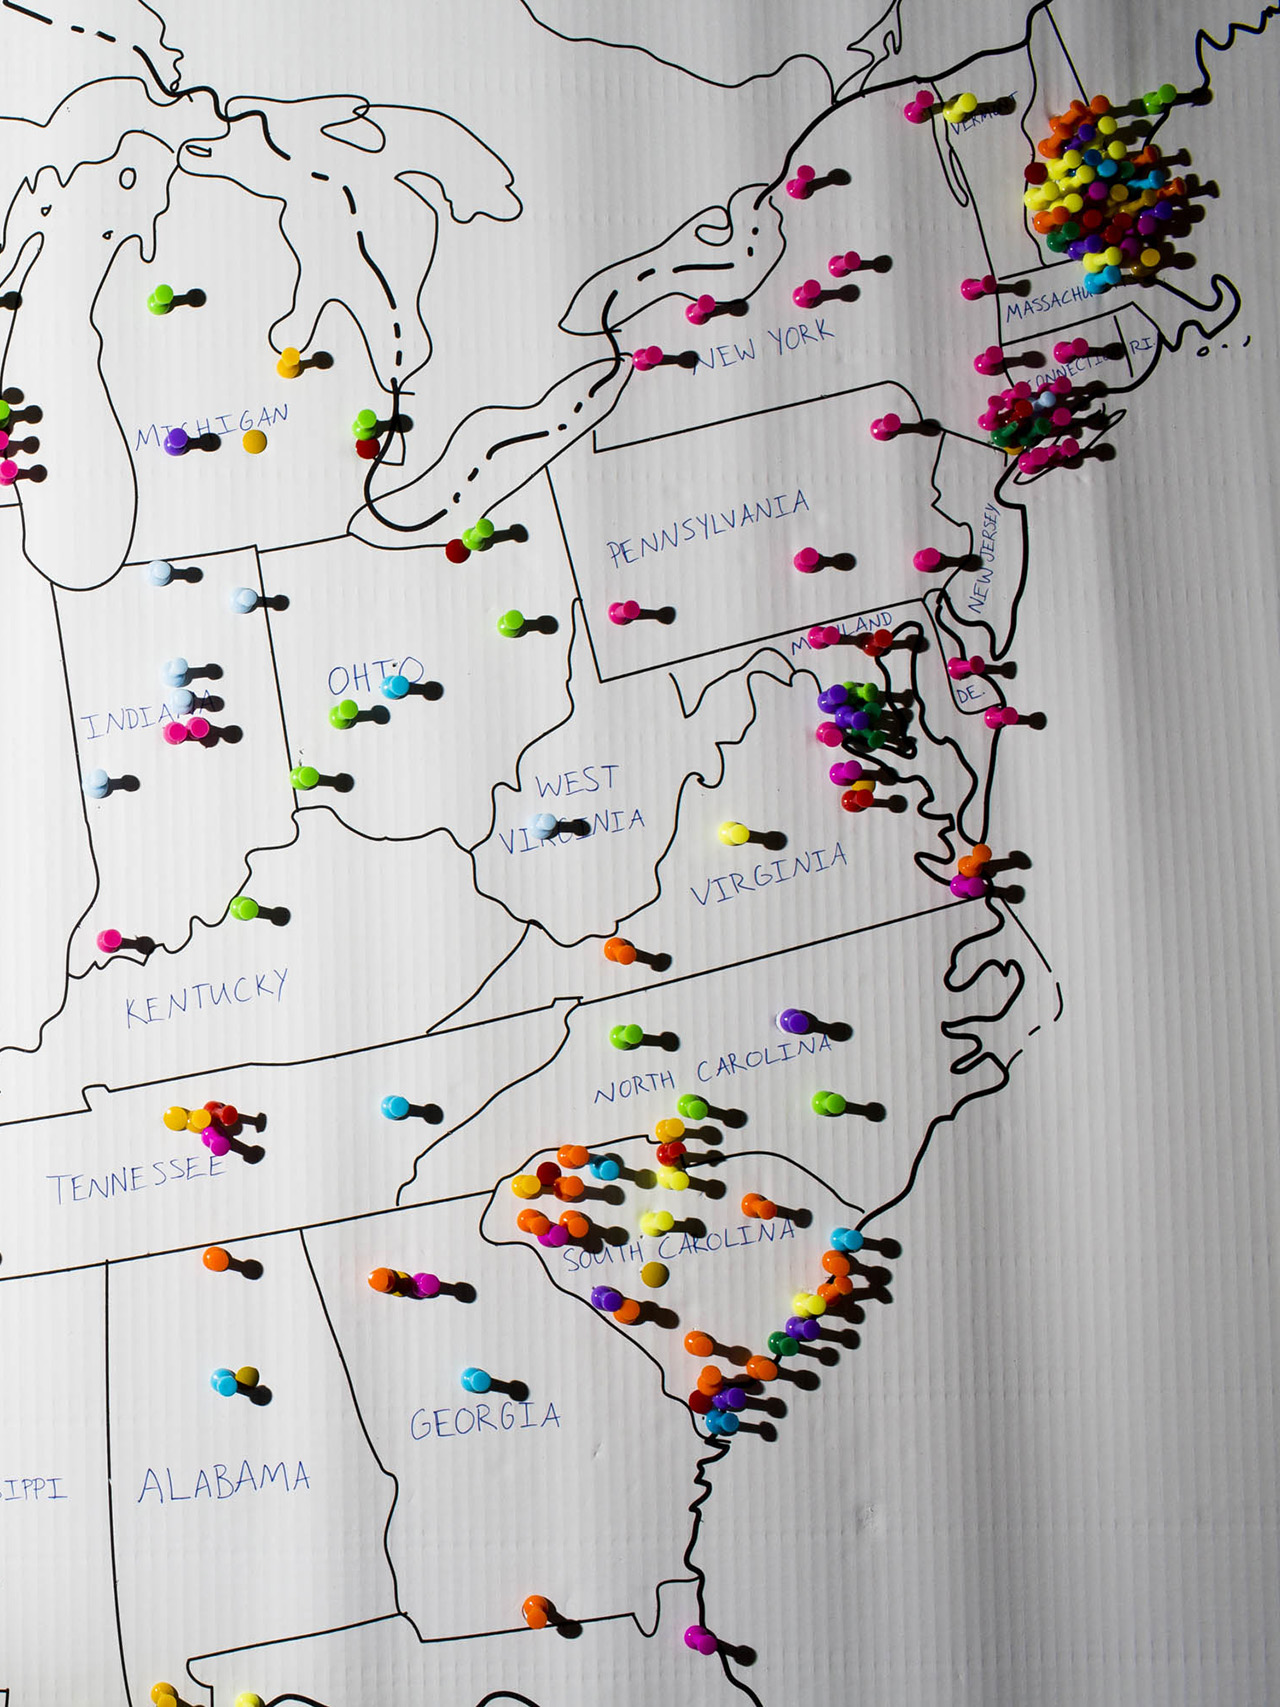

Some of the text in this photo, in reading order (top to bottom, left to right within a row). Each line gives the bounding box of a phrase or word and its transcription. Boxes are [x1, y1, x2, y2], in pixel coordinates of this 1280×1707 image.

[693, 318, 836, 376] NEW YORK
[607, 489, 810, 568] PENNSYLVANIA
[968, 503, 1001, 614] NEW JERSEY
[791, 611, 894, 656] MLAND
[328, 656, 424, 696] OHIO
[80, 689, 218, 740] INDIAA
[535, 765, 620, 798] WEST
[691, 842, 848, 906] VIRGINIA
[126, 967, 288, 1028] KENTUCKY
[594, 1033, 833, 1105] NORTH CAROLINA
[46, 1153, 228, 1206] TENNESSEE
[563, 1218, 795, 1272] SOUTH CAROLINA
[411, 1402, 562, 1442] GEORGIA
[138, 1460, 311, 1504] ALABAMA
